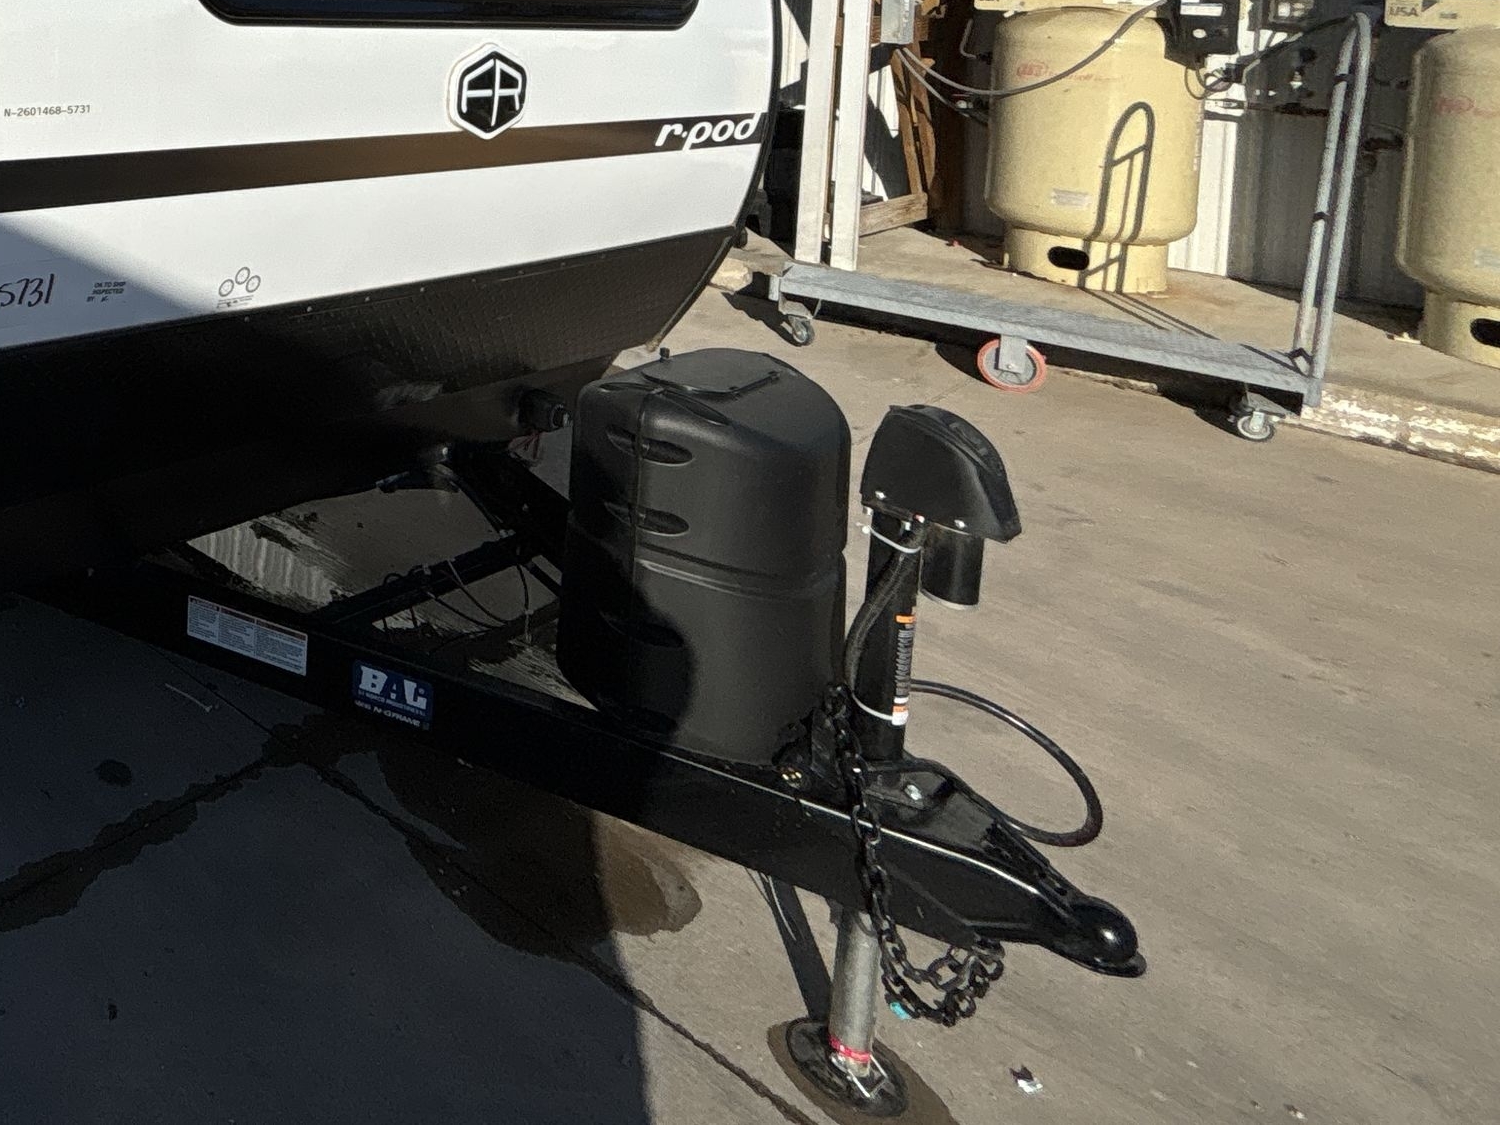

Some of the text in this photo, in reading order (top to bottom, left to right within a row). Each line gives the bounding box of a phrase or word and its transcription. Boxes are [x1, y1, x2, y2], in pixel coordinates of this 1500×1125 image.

[1388, 6, 1419, 17] USA
[3, 104, 91, 117] N-2601468-5731
[359, 665, 427, 710] BAL
